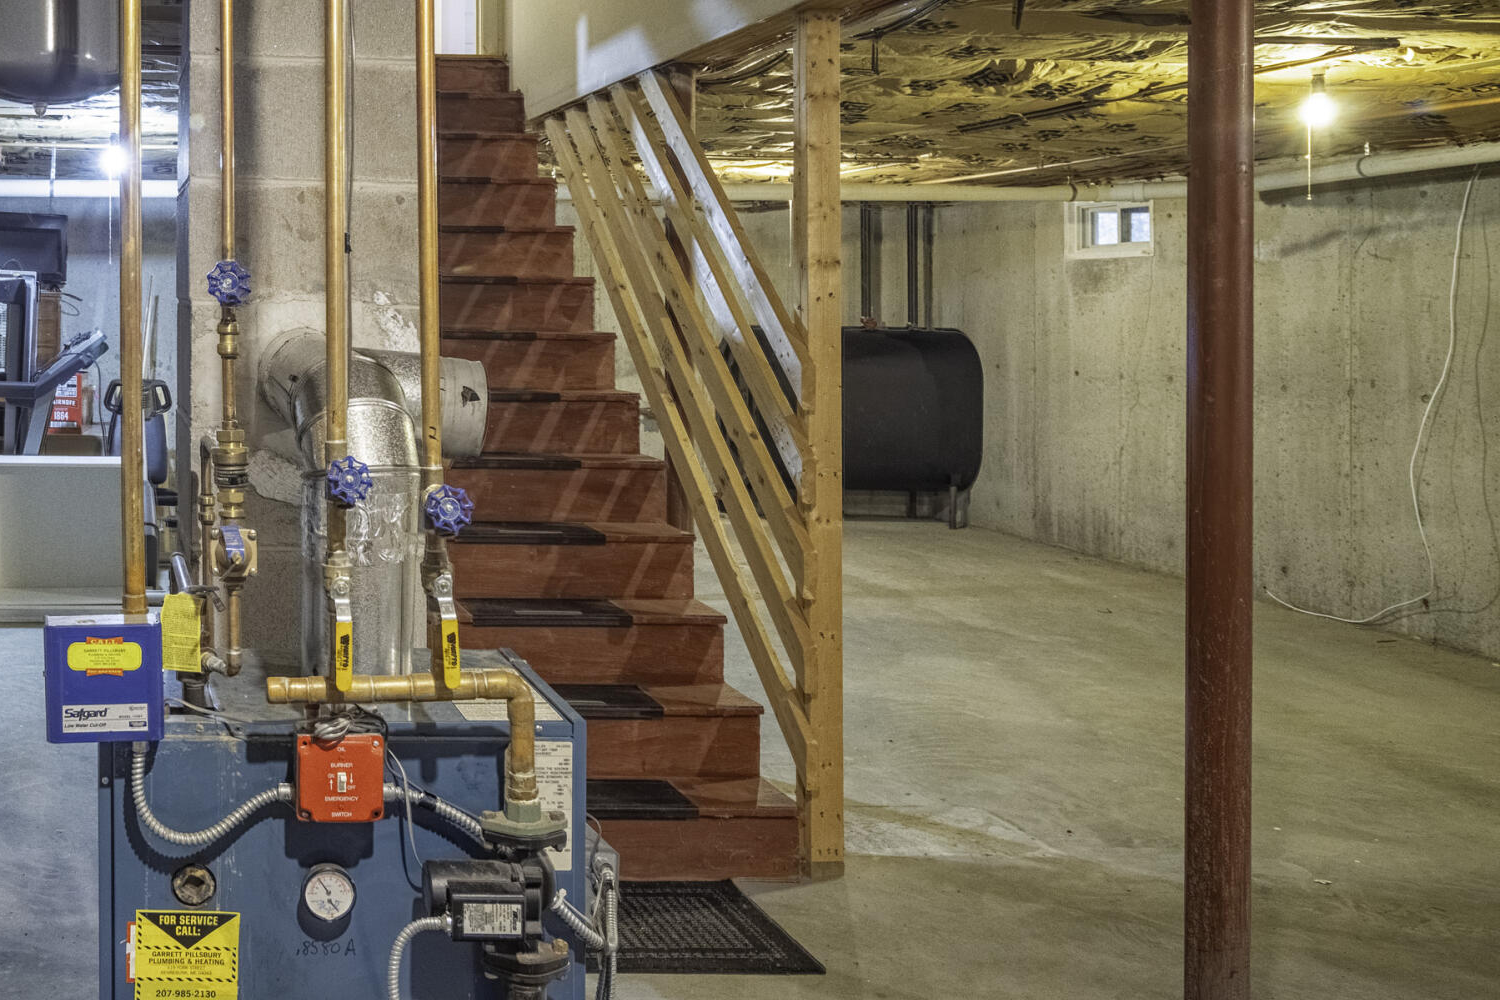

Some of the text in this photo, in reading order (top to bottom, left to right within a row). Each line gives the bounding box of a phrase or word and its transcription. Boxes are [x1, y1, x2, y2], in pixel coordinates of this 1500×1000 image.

[54, 411, 68, 420] 1864
[64, 707, 108, 721] Safgard
[159, 915, 218, 926] FOR SERVICE
[176, 926, 201, 936] CALL:
[156, 990, 216, 998] 207-985-2130
